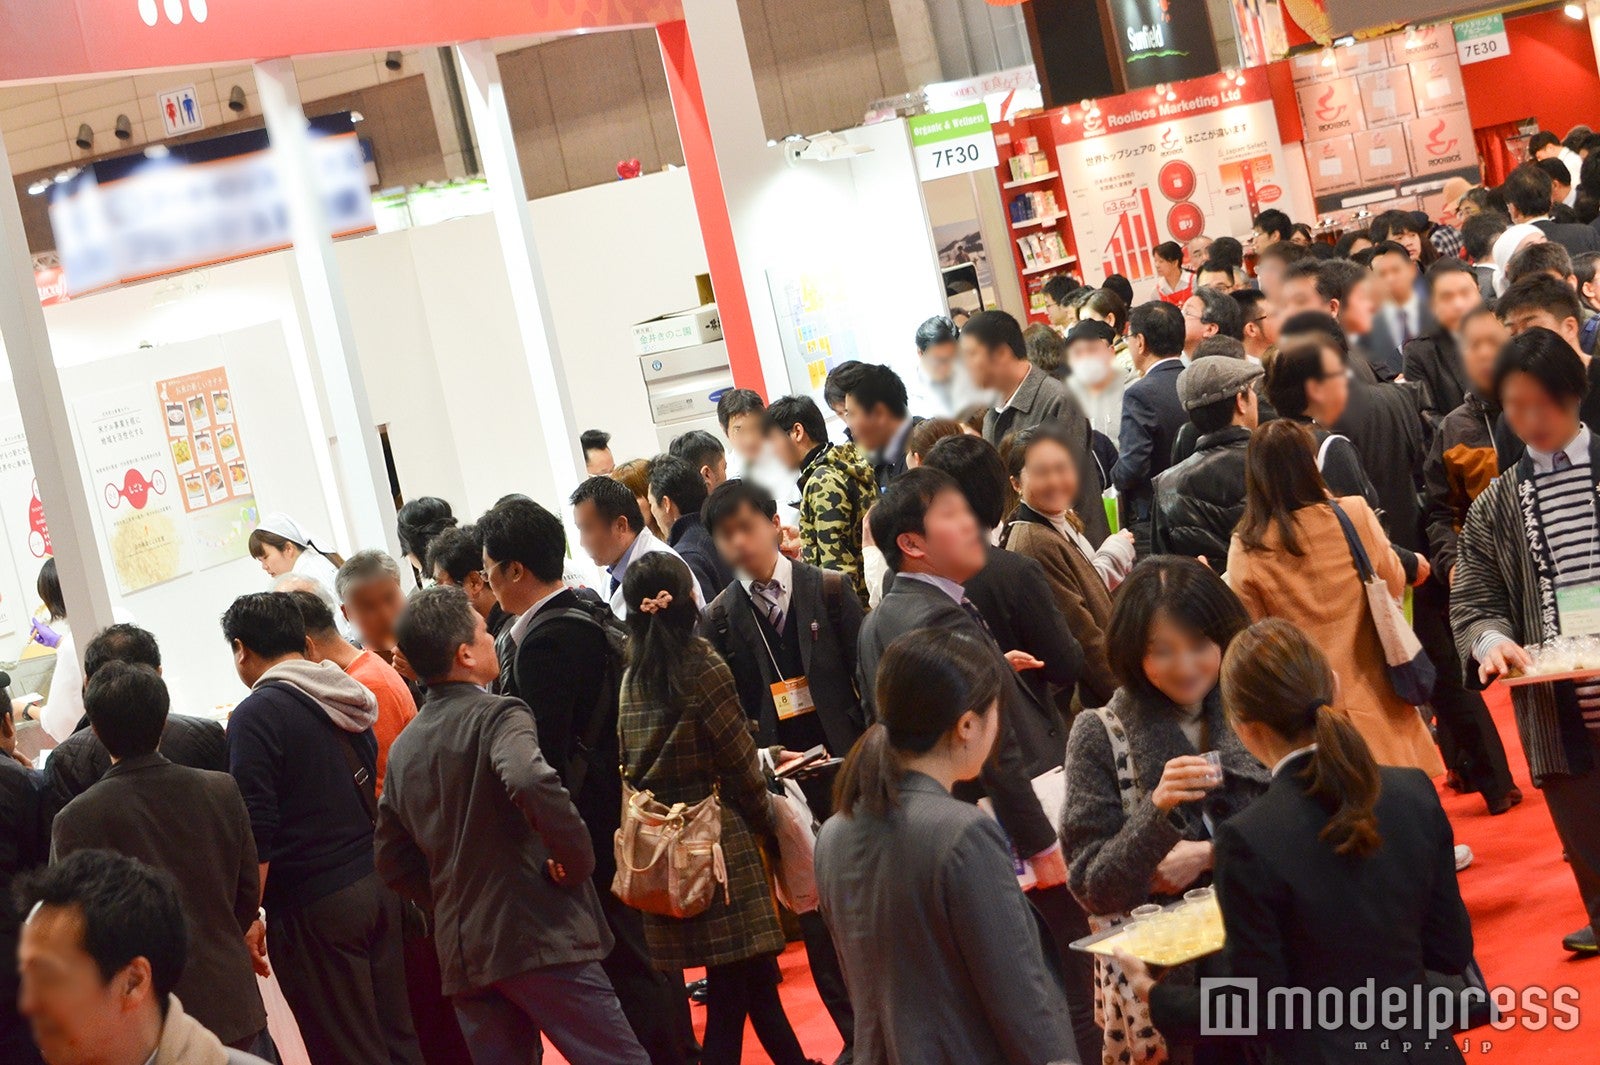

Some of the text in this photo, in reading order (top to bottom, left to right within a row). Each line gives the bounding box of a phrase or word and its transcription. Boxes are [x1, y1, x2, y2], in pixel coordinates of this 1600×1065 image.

[1465, 41, 1497, 57] 7E30
[1107, 88, 1241, 128] Rooibos Marketing Ltd
[913, 114, 985, 137] Organic & Wellness
[932, 144, 979, 168] 7F30
[1085, 143, 1156, 167] 世界トップシェアの
[1185, 123, 1247, 144] はここが違います
